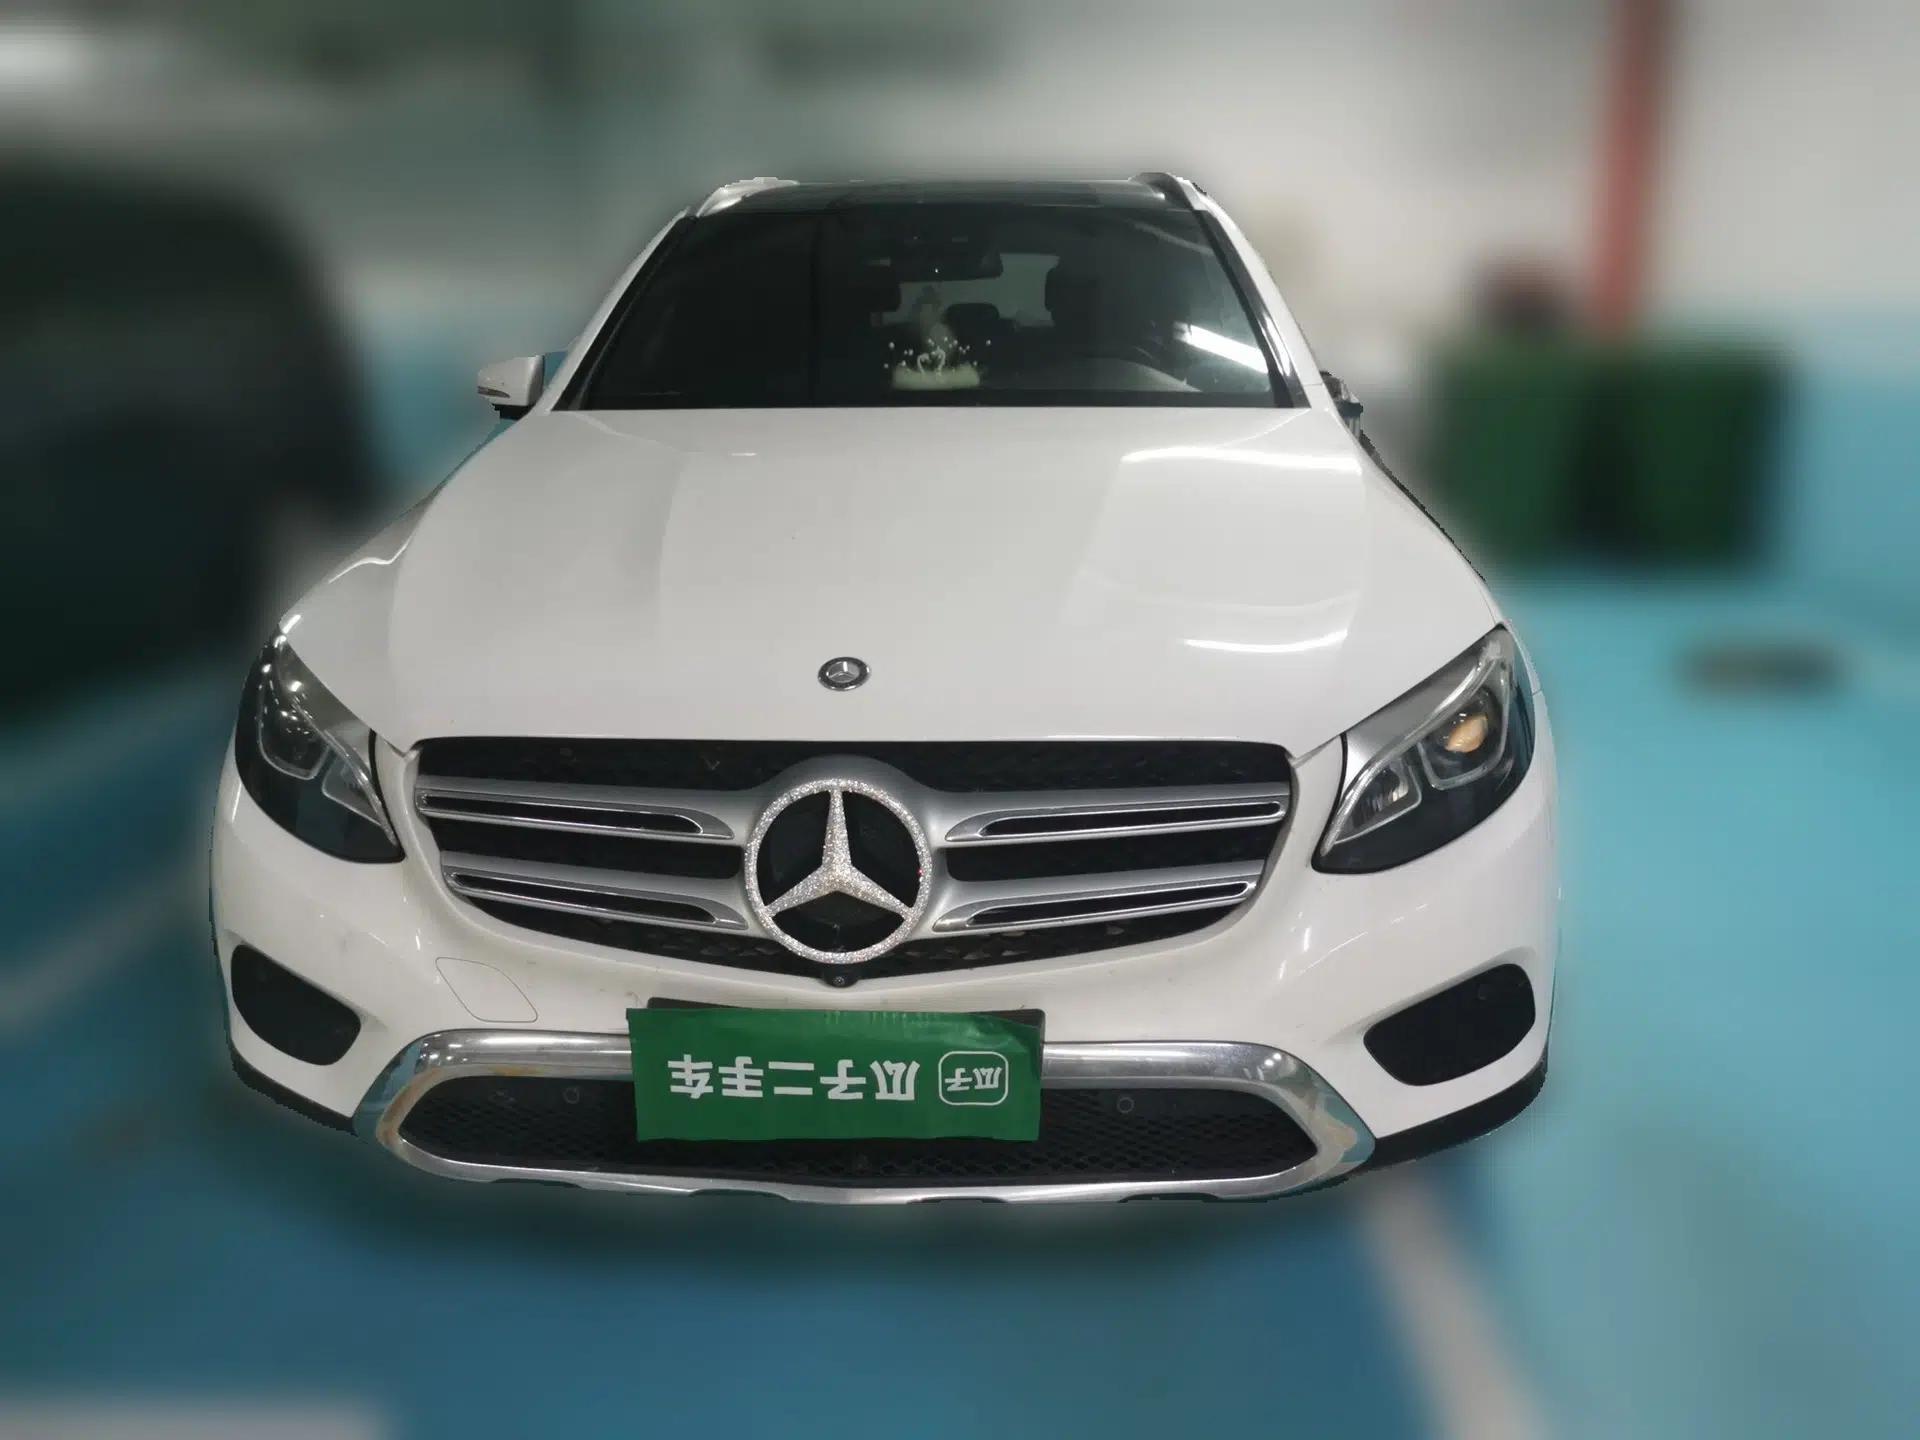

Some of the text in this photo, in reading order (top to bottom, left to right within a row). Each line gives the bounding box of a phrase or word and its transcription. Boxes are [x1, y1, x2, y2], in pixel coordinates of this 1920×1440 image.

[667, 1053, 920, 1100] 瓜子二手车
[944, 1066, 1002, 1091] 瓜子
